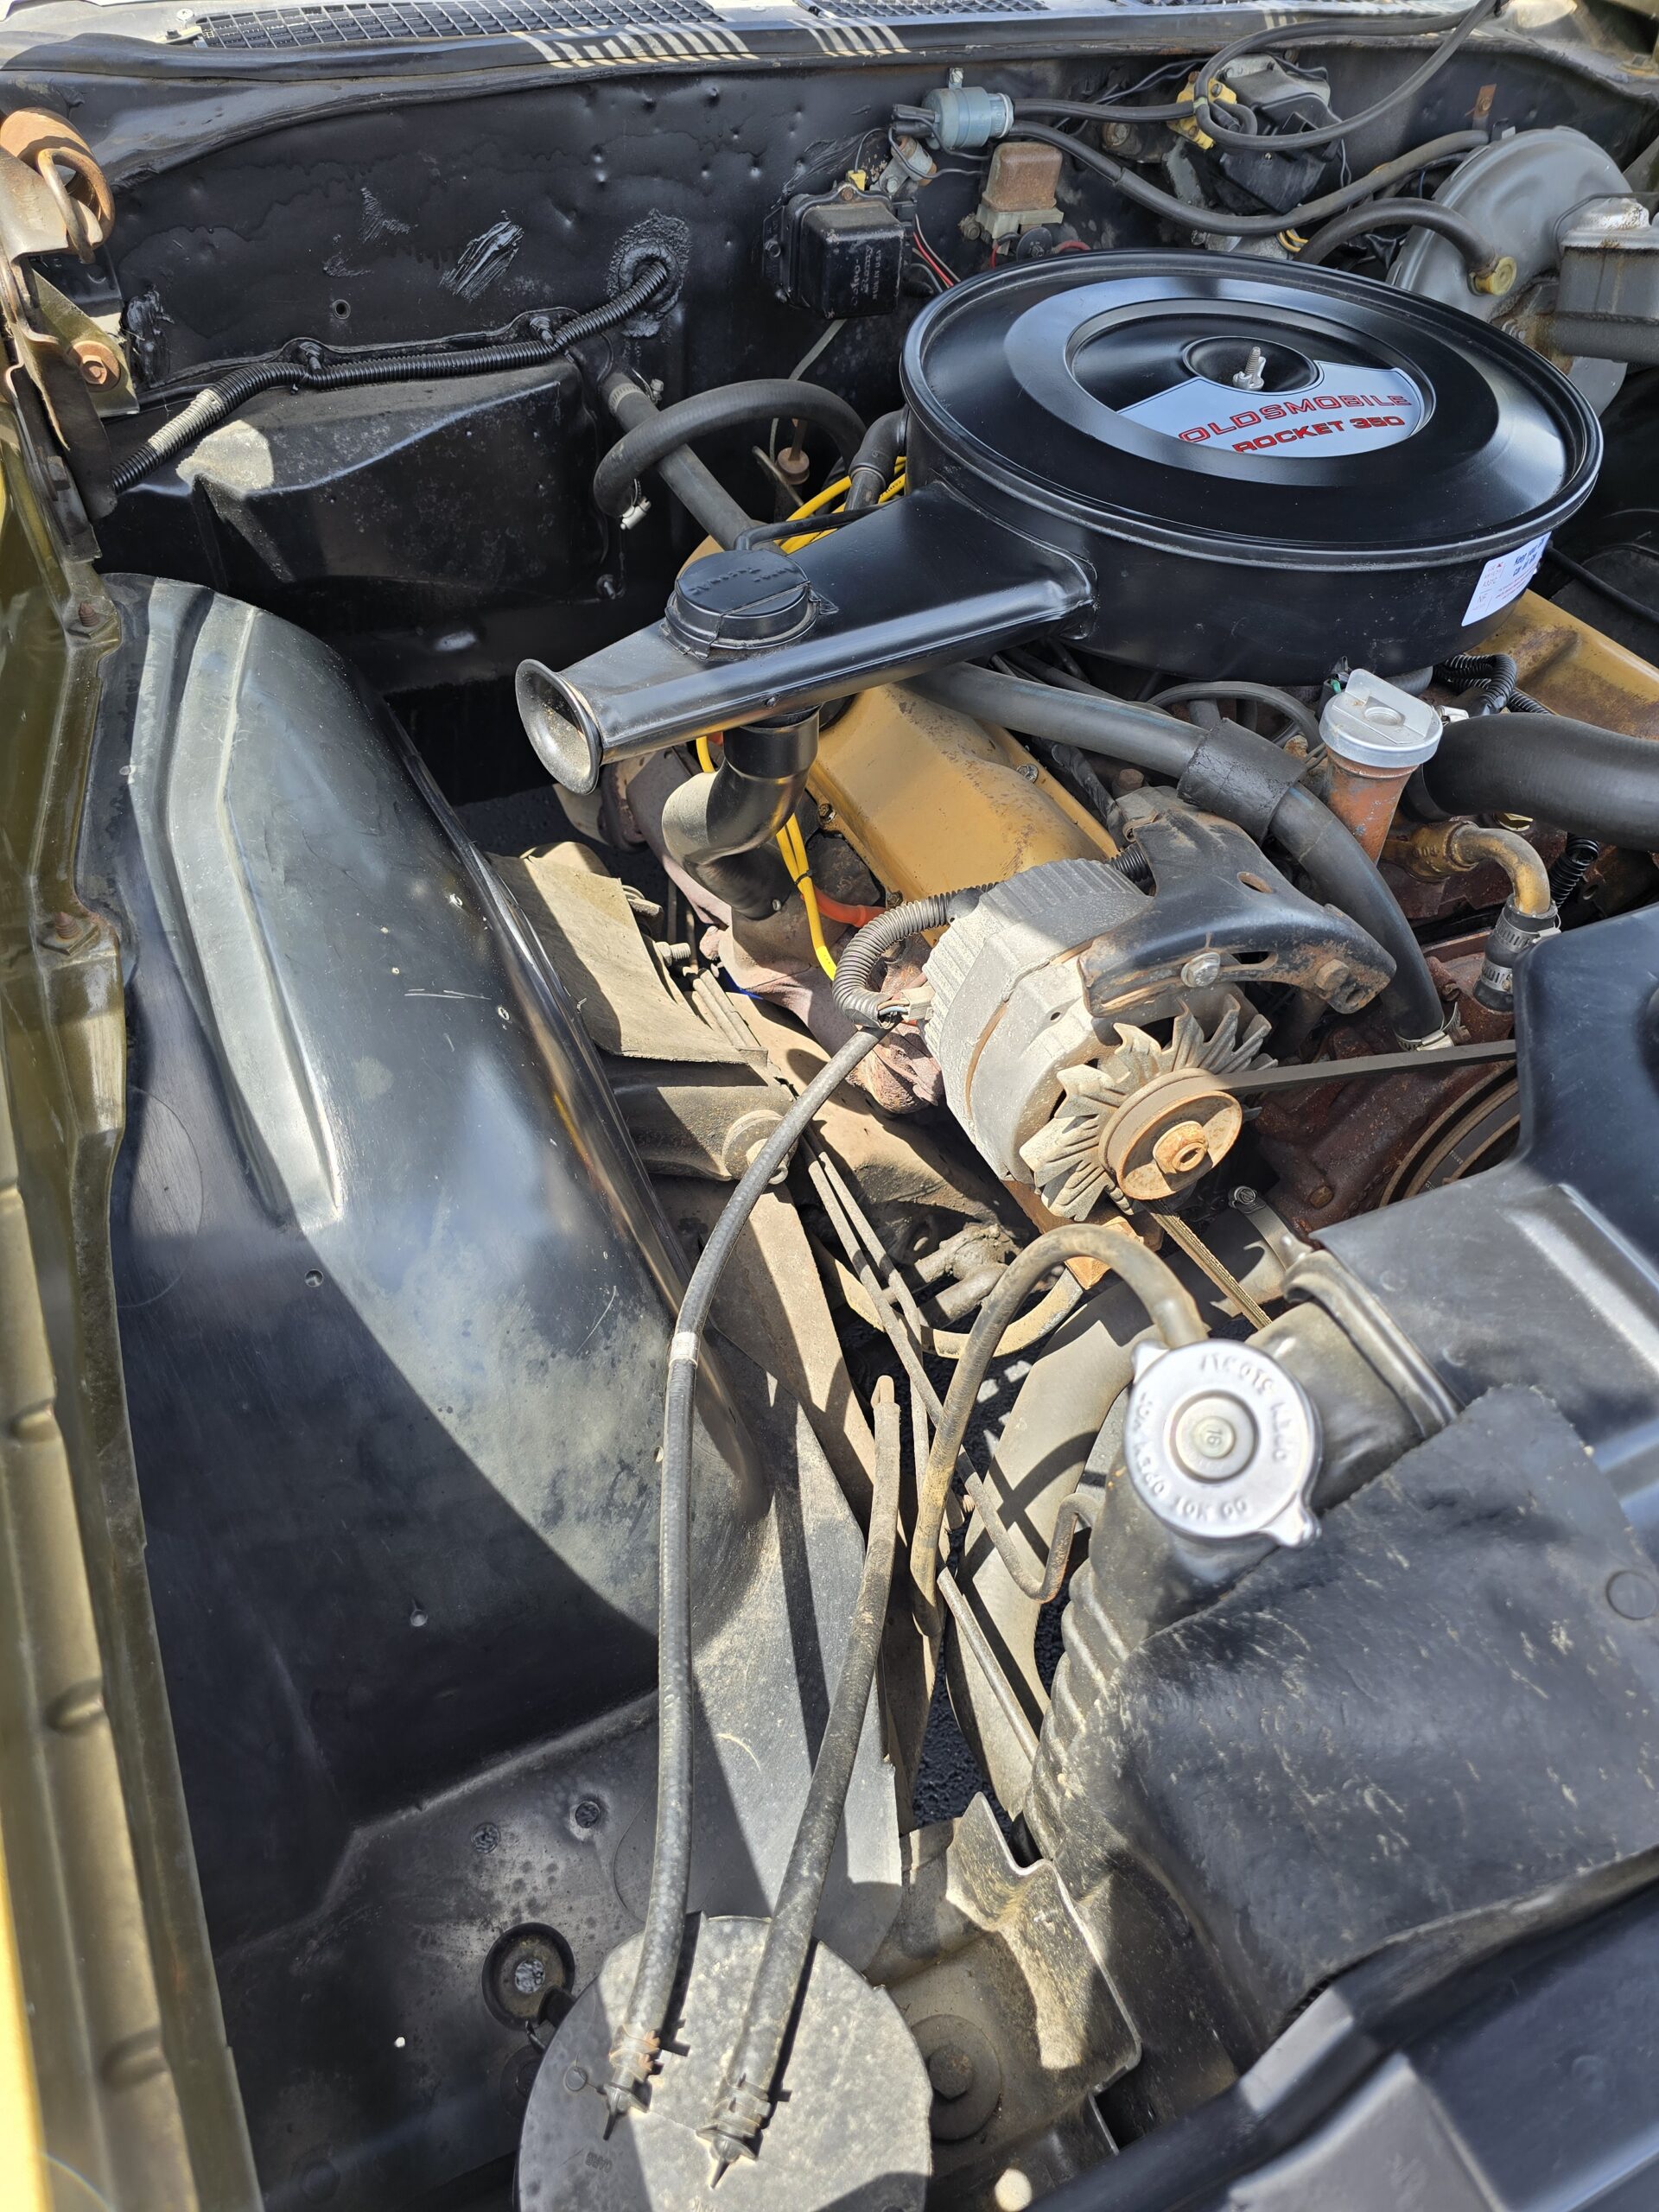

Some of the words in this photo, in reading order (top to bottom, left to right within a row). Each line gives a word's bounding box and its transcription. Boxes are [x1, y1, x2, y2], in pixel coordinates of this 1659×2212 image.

[1178, 394, 1413, 443] OLDSMOBILE
[1232, 419, 1344, 454] ROCKET
[1350, 415, 1406, 429] 350
